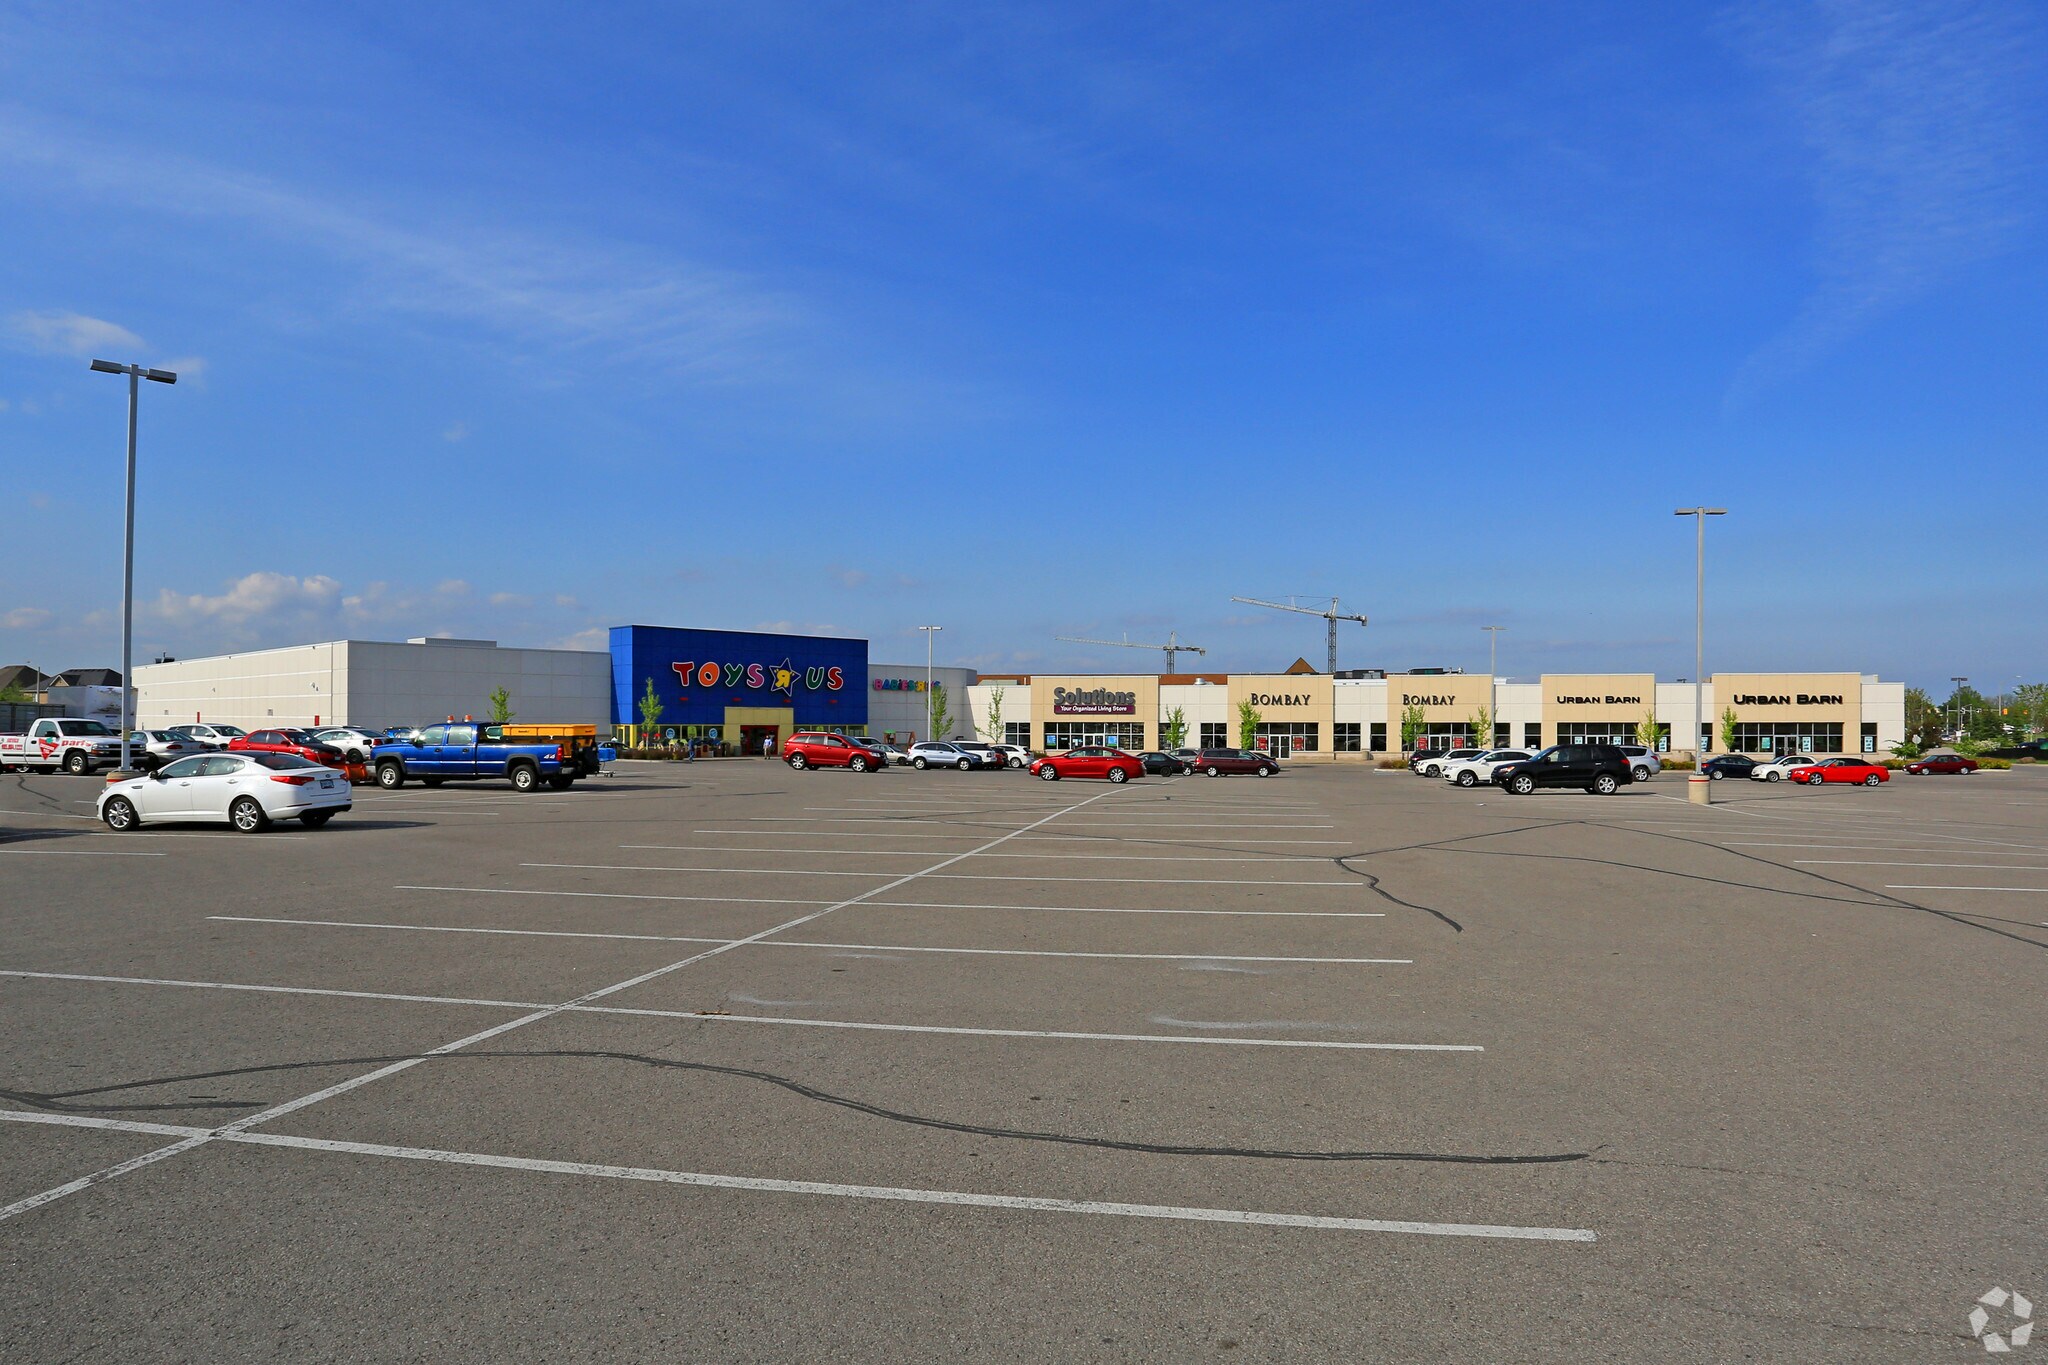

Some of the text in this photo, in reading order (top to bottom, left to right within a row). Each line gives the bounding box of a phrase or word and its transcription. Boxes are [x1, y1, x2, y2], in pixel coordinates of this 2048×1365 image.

[672, 661, 765, 688] TOYS
[805, 666, 844, 690] US
[1054, 687, 1136, 705] Solutions
[1251, 692, 1311, 706] BOMBAY
[1402, 694, 1456, 706] BOMBAY
[1556, 695, 1641, 704] URBAN BARN
[1733, 694, 1843, 705] URBAN BARN
[1098, 705, 1112, 713] Living
